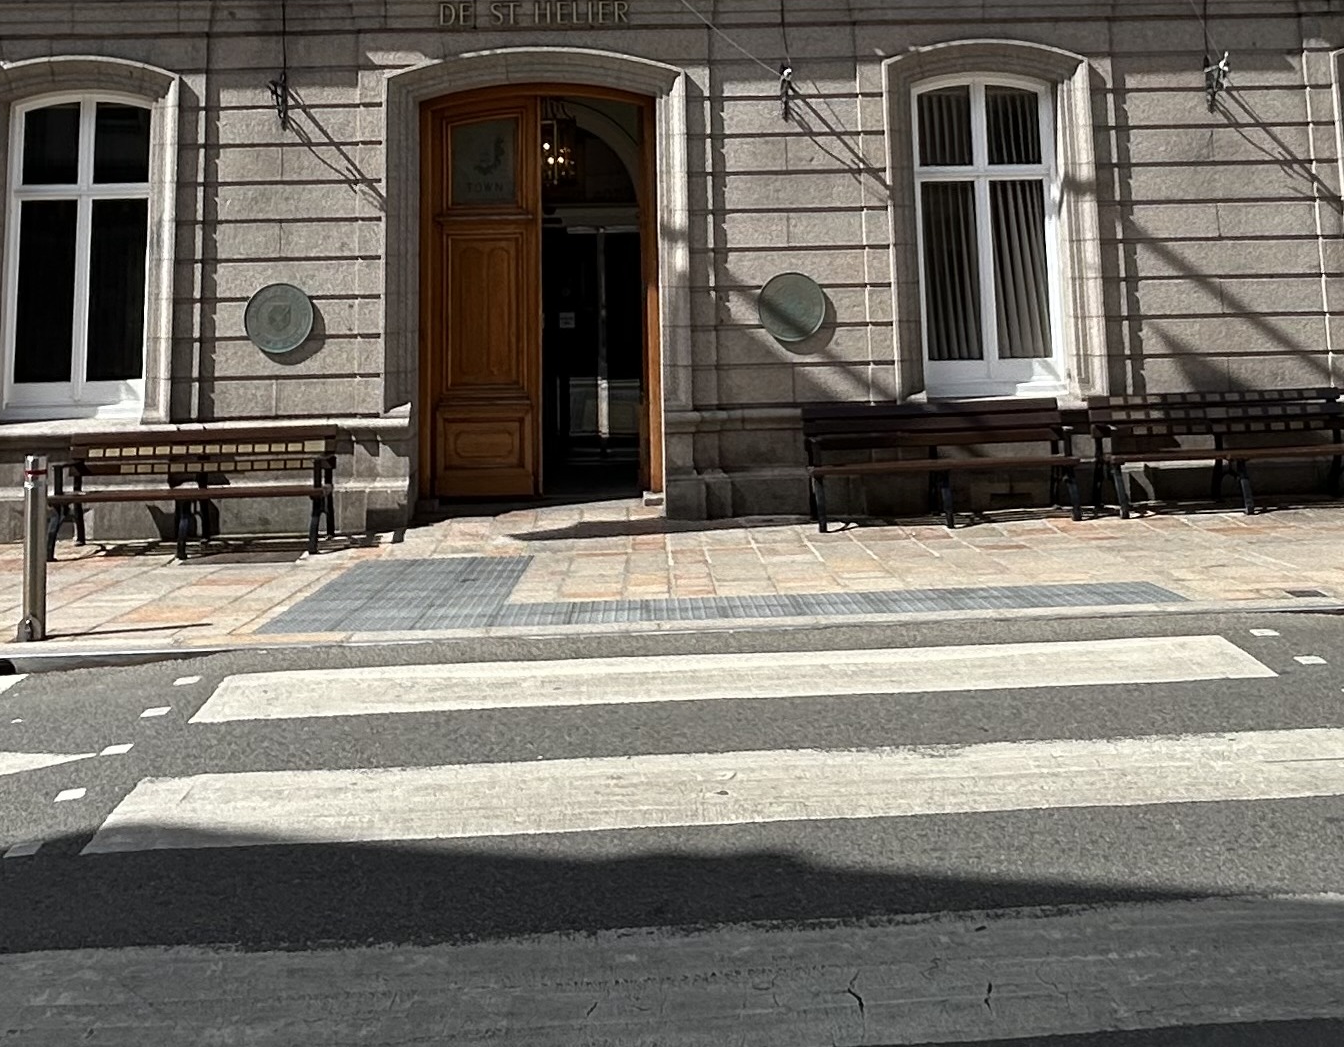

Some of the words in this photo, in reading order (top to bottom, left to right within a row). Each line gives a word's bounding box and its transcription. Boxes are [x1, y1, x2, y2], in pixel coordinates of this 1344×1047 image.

[439, 2, 473, 26] DE
[489, 2, 524, 26] ST
[534, 0, 630, 24] HELIER
[465, 182, 504, 193] TOWN
